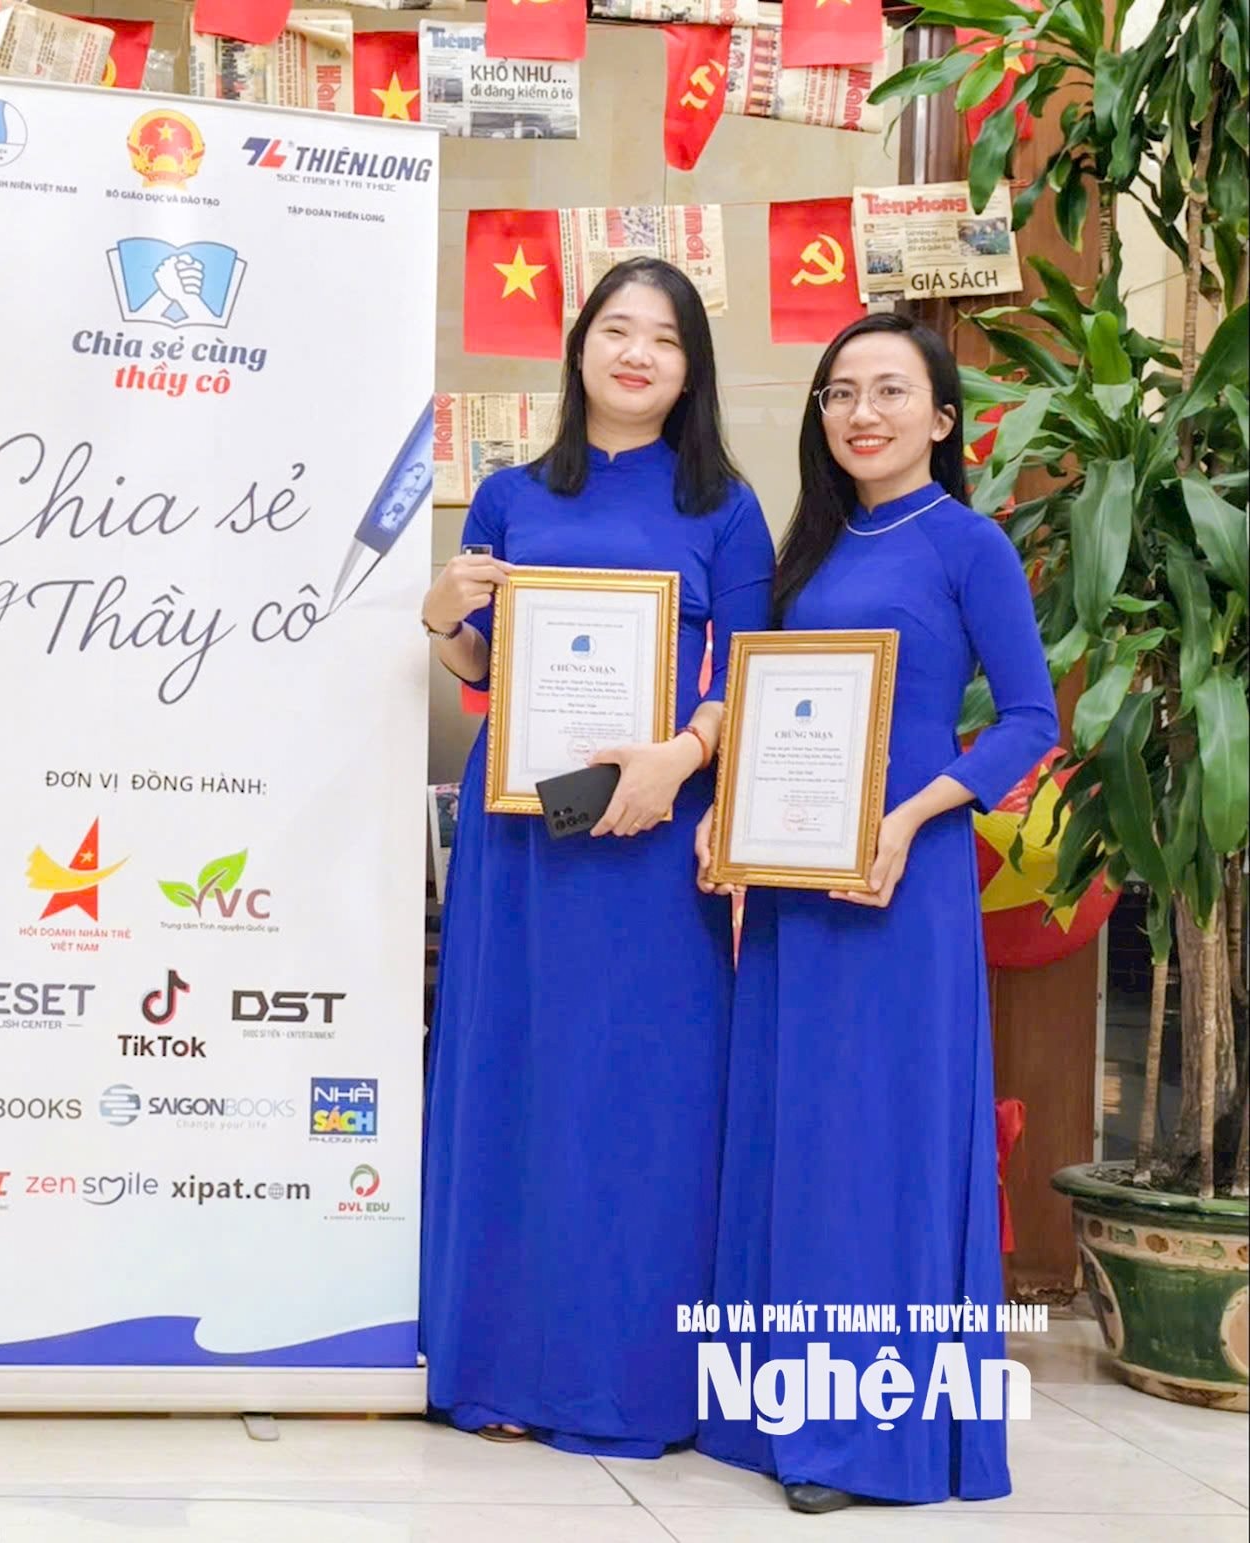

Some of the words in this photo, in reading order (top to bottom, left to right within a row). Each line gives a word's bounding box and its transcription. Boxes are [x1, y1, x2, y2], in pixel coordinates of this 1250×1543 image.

[470, 84, 481, 97] đi
[561, 87, 573, 100] tô
[9, 179, 32, 191] NIÊN
[34, 182, 53, 193] VIỆT
[56, 185, 78, 194] NAM
[106, 189, 119, 199] BỘ
[121, 190, 143, 200] GIÁO
[287, 205, 304, 215] TẬP
[306, 206, 331, 218] ĐOÀN
[333, 208, 359, 220] THIÊN
[361, 212, 385, 222] LONG
[911, 268, 945, 291] GIÁ
[950, 267, 998, 290] SÁCH
[72, 330, 143, 358] Chia
[150, 336, 184, 360] sẻ
[191, 337, 267, 372] cùng
[114, 362, 188, 397] thầy
[195, 368, 231, 394] cô
[215, 462, 311, 534] sẻ
[26, 575, 237, 704] Thầy
[252, 584, 331, 642] cô
[45, 770, 92, 789] ĐƠN
[99, 773, 119, 792] VỊ
[131, 768, 193, 794] ĐỒNG
[200, 772, 268, 796] HÀNH:
[19, 926, 37, 937] HỘI
[40, 927, 76, 937] DOANH
[78, 928, 108, 938] NHÂN
[111, 927, 132, 939] TRẺ
[50, 941, 73, 952] VIỆT
[76, 943, 99, 952] NAM
[232, 990, 347, 1023] DST
[21, 1020, 62, 1029] CENTER
[117, 1033, 207, 1059] TikTok
[314, 1082, 374, 1103] NHÀ
[176, 1119, 215, 1130] Change
[220, 1121, 243, 1130] your
[247, 1120, 268, 1129] life
[313, 1105, 374, 1132] SÁCH
[25, 1175, 76, 1194] zen
[171, 1175, 311, 1205] xipat.com
[338, 1202, 363, 1212] DVL
[366, 1202, 390, 1213] EDU
